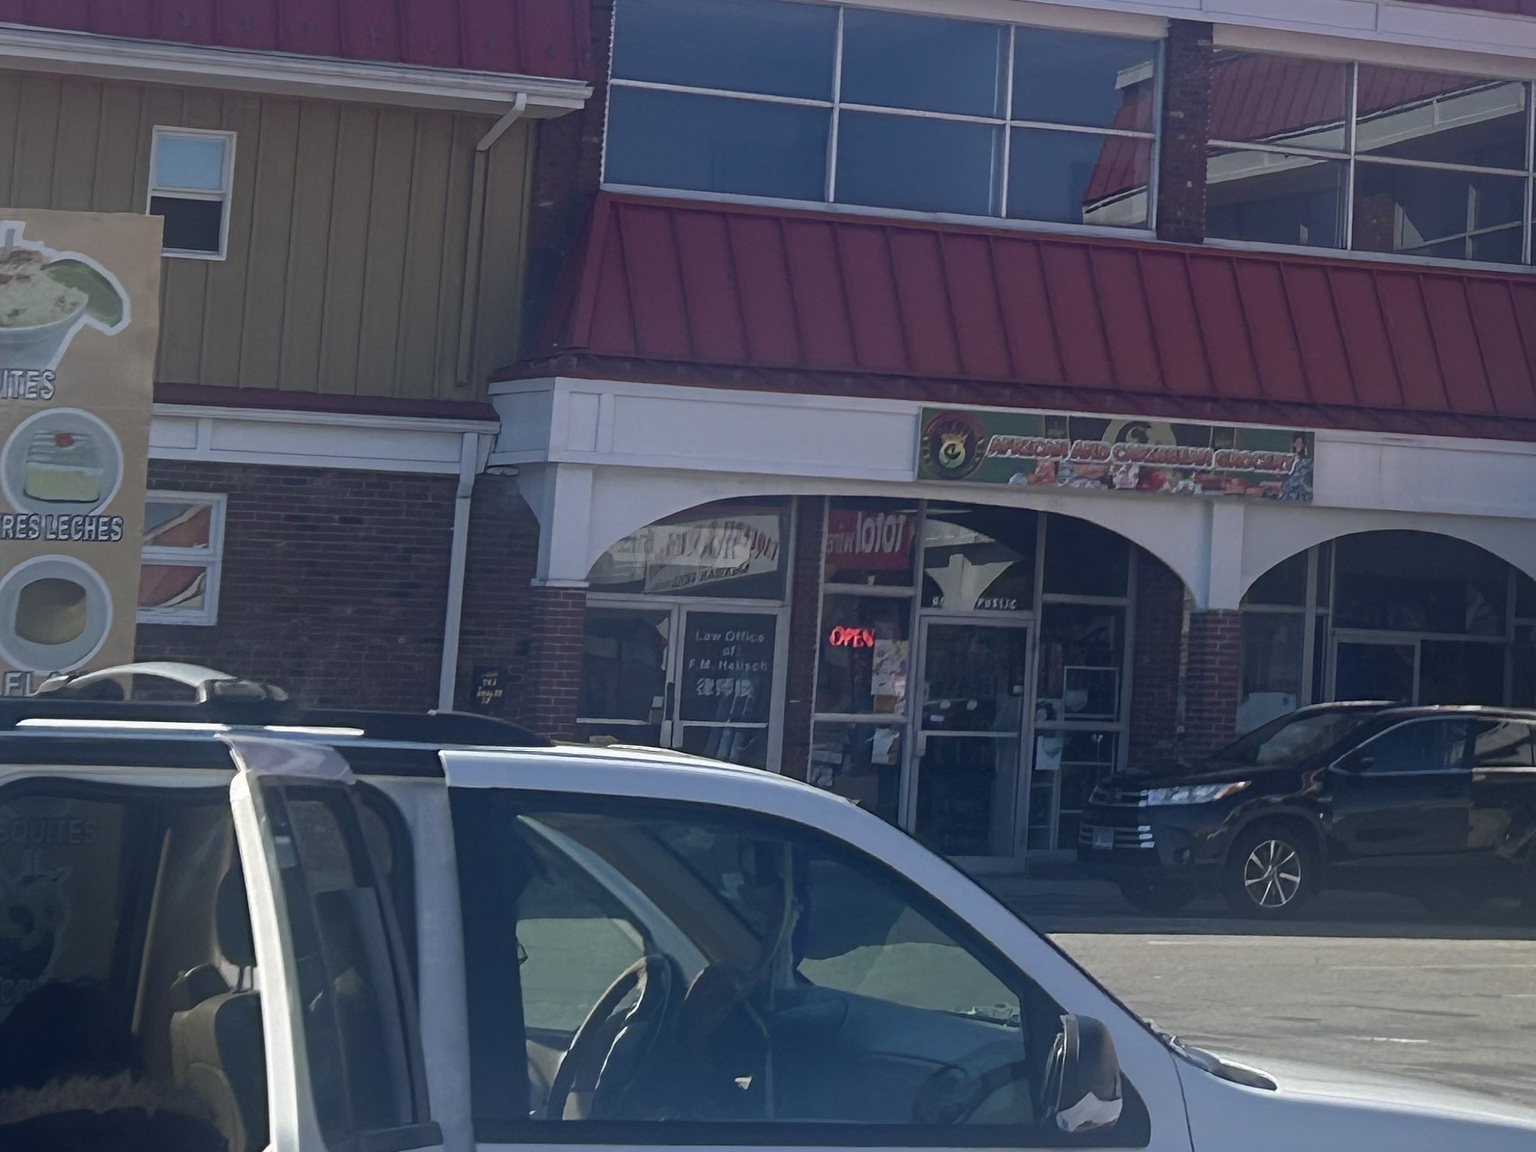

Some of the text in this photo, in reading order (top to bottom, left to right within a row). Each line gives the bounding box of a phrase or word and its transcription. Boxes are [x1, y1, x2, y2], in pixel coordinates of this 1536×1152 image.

[0, 513, 124, 542] RES LECHES
[829, 626, 874, 648] OPEN
